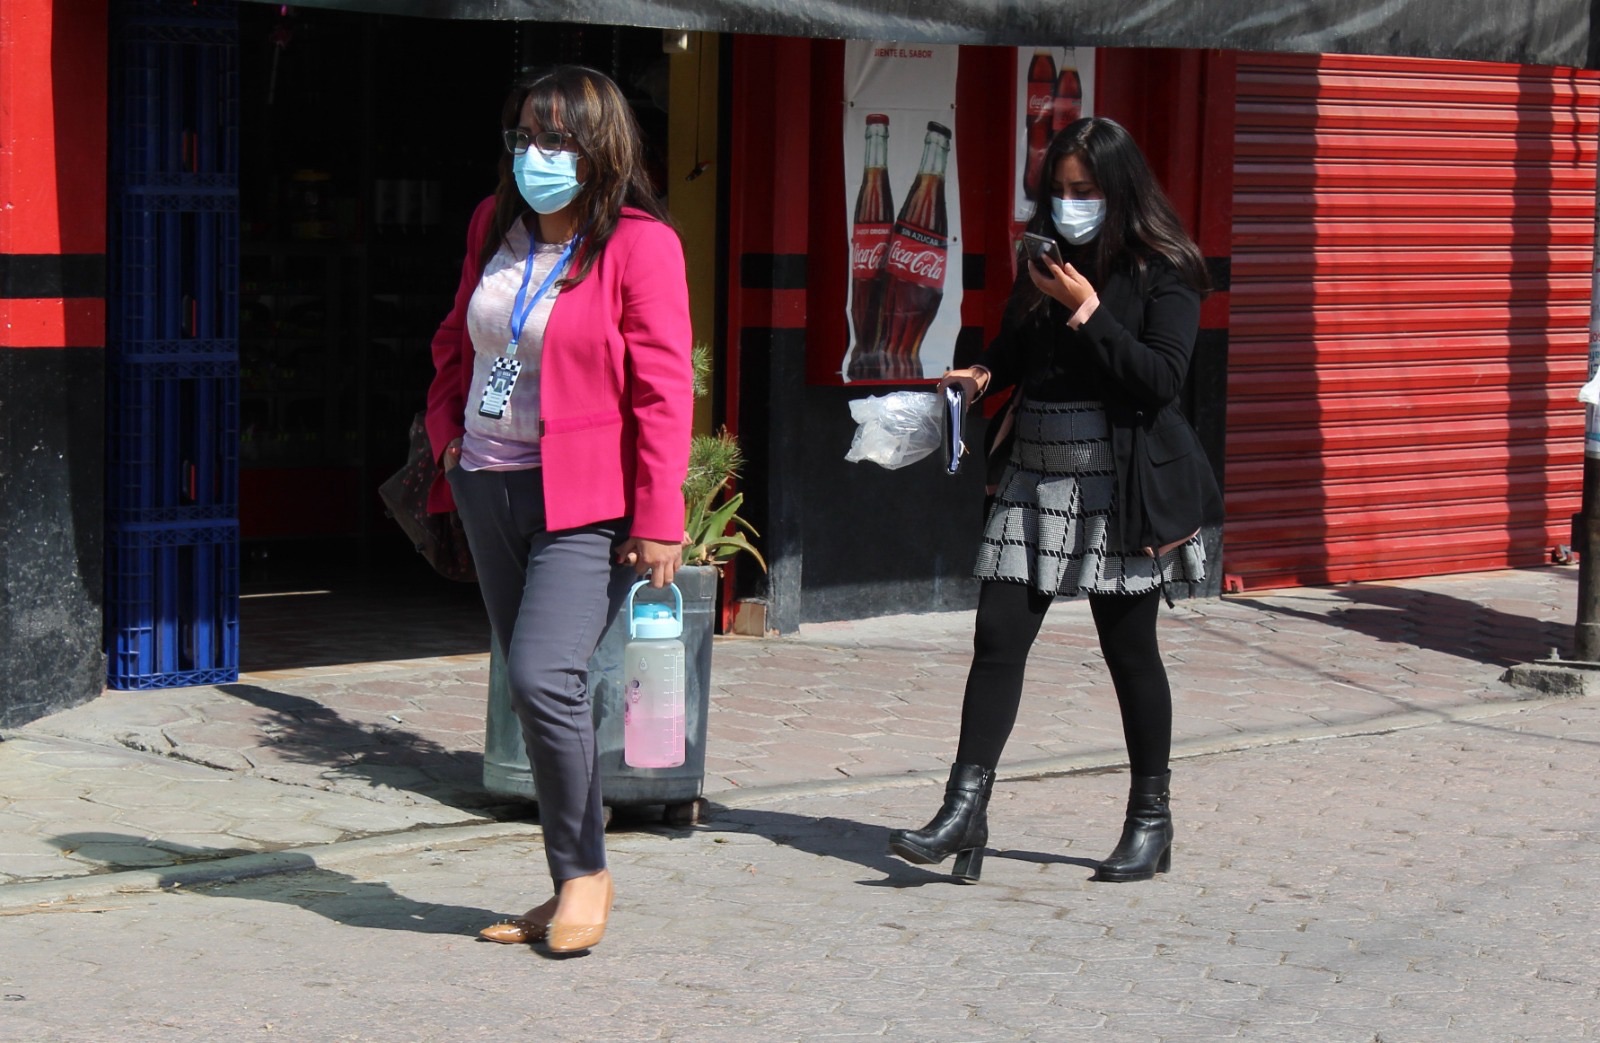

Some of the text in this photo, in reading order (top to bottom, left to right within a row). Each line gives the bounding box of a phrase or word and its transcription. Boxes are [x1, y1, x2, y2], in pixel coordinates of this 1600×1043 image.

[899, 48, 907, 58] EL
[909, 49, 933, 58] SABOR
[901, 227, 912, 237] SIN
[889, 241, 944, 280] Coca-Cola
